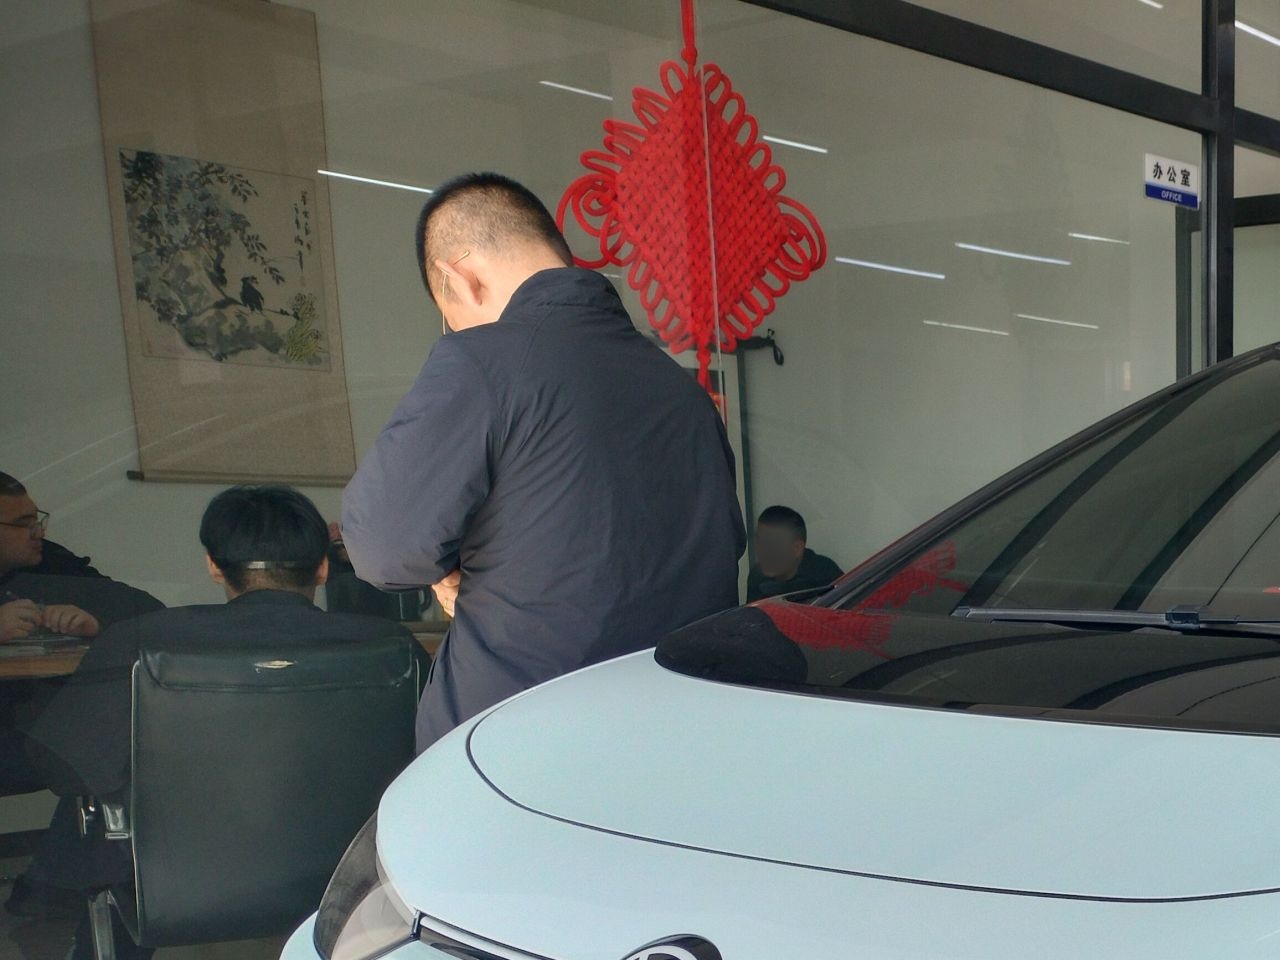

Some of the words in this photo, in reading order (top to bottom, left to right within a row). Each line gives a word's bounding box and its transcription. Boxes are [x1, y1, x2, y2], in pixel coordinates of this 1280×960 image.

[1152, 161, 1191, 187] 办公室
[1161, 190, 1183, 202] OFFICE
